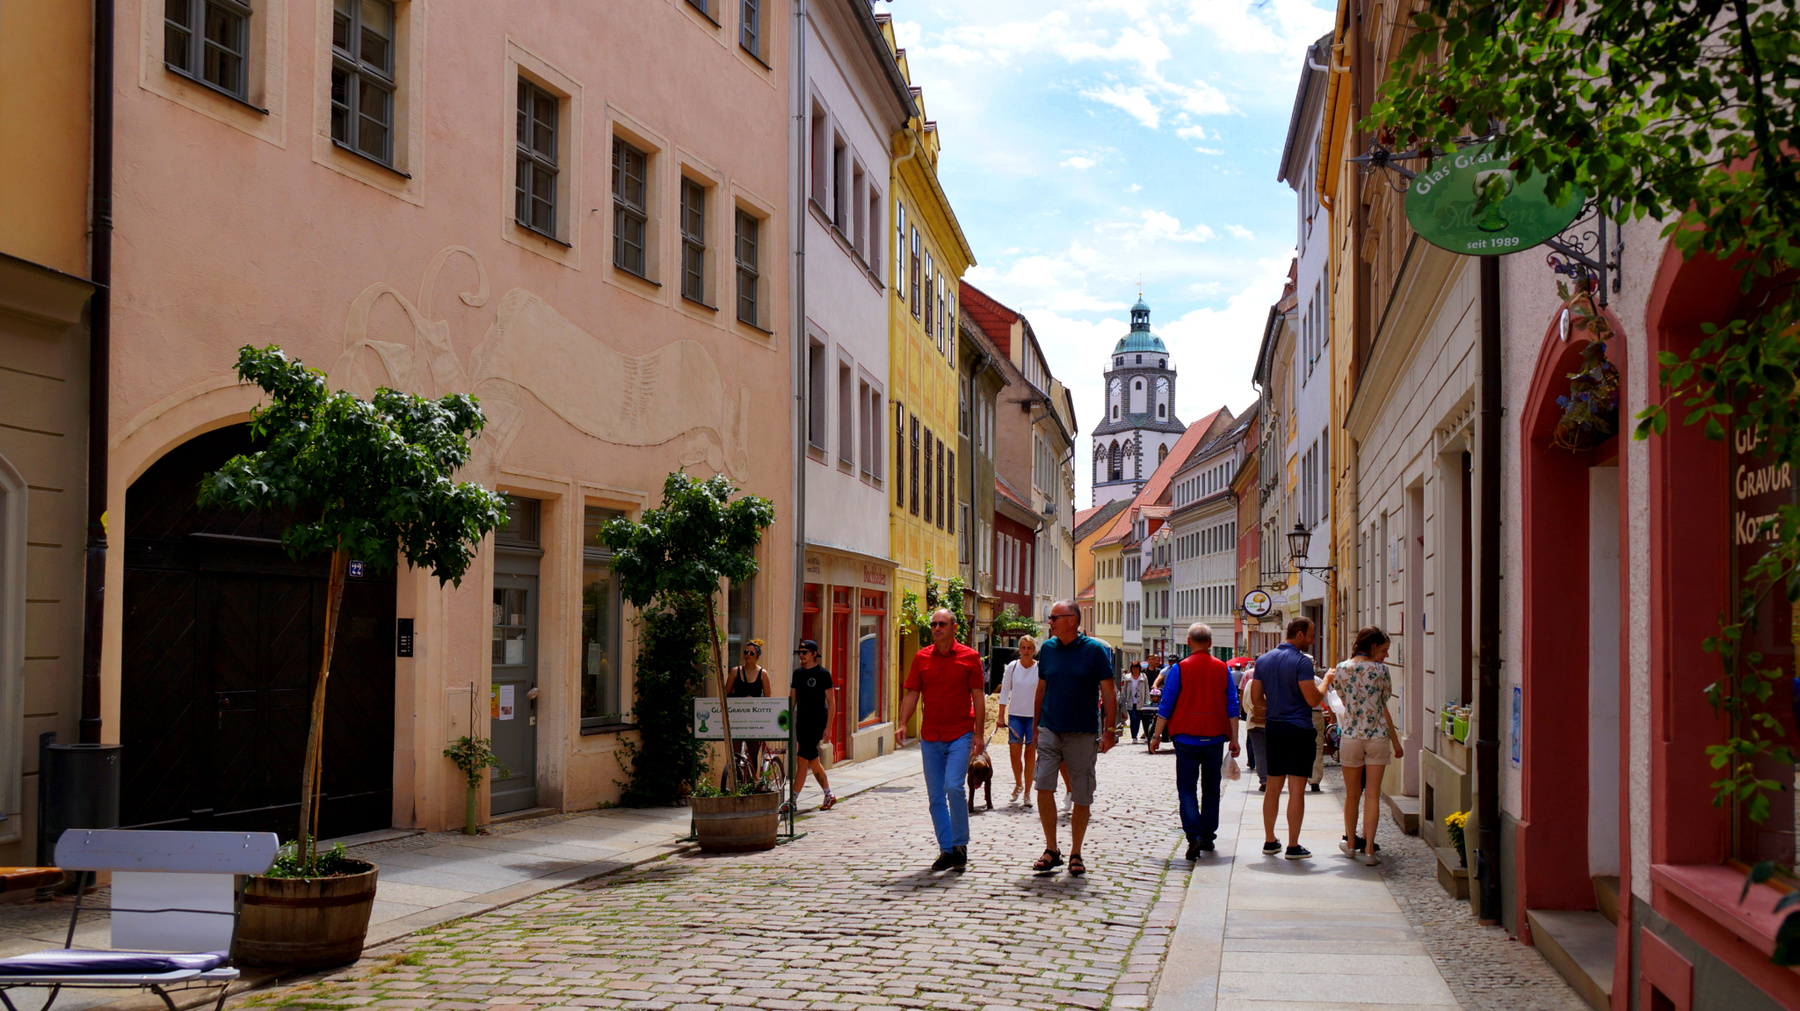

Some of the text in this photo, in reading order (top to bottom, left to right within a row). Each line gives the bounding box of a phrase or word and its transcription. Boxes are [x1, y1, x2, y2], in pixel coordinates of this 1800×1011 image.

[1416, 151, 1517, 195] Glas Gravu
[1467, 236, 1520, 250] seit 1989
[1735, 424, 1769, 455] GLA
[1735, 461, 1791, 500] GRAVUR
[351, 563, 362, 575] 22
[863, 565, 886, 585] Buchladen
[752, 706, 772, 714] KOTTE
